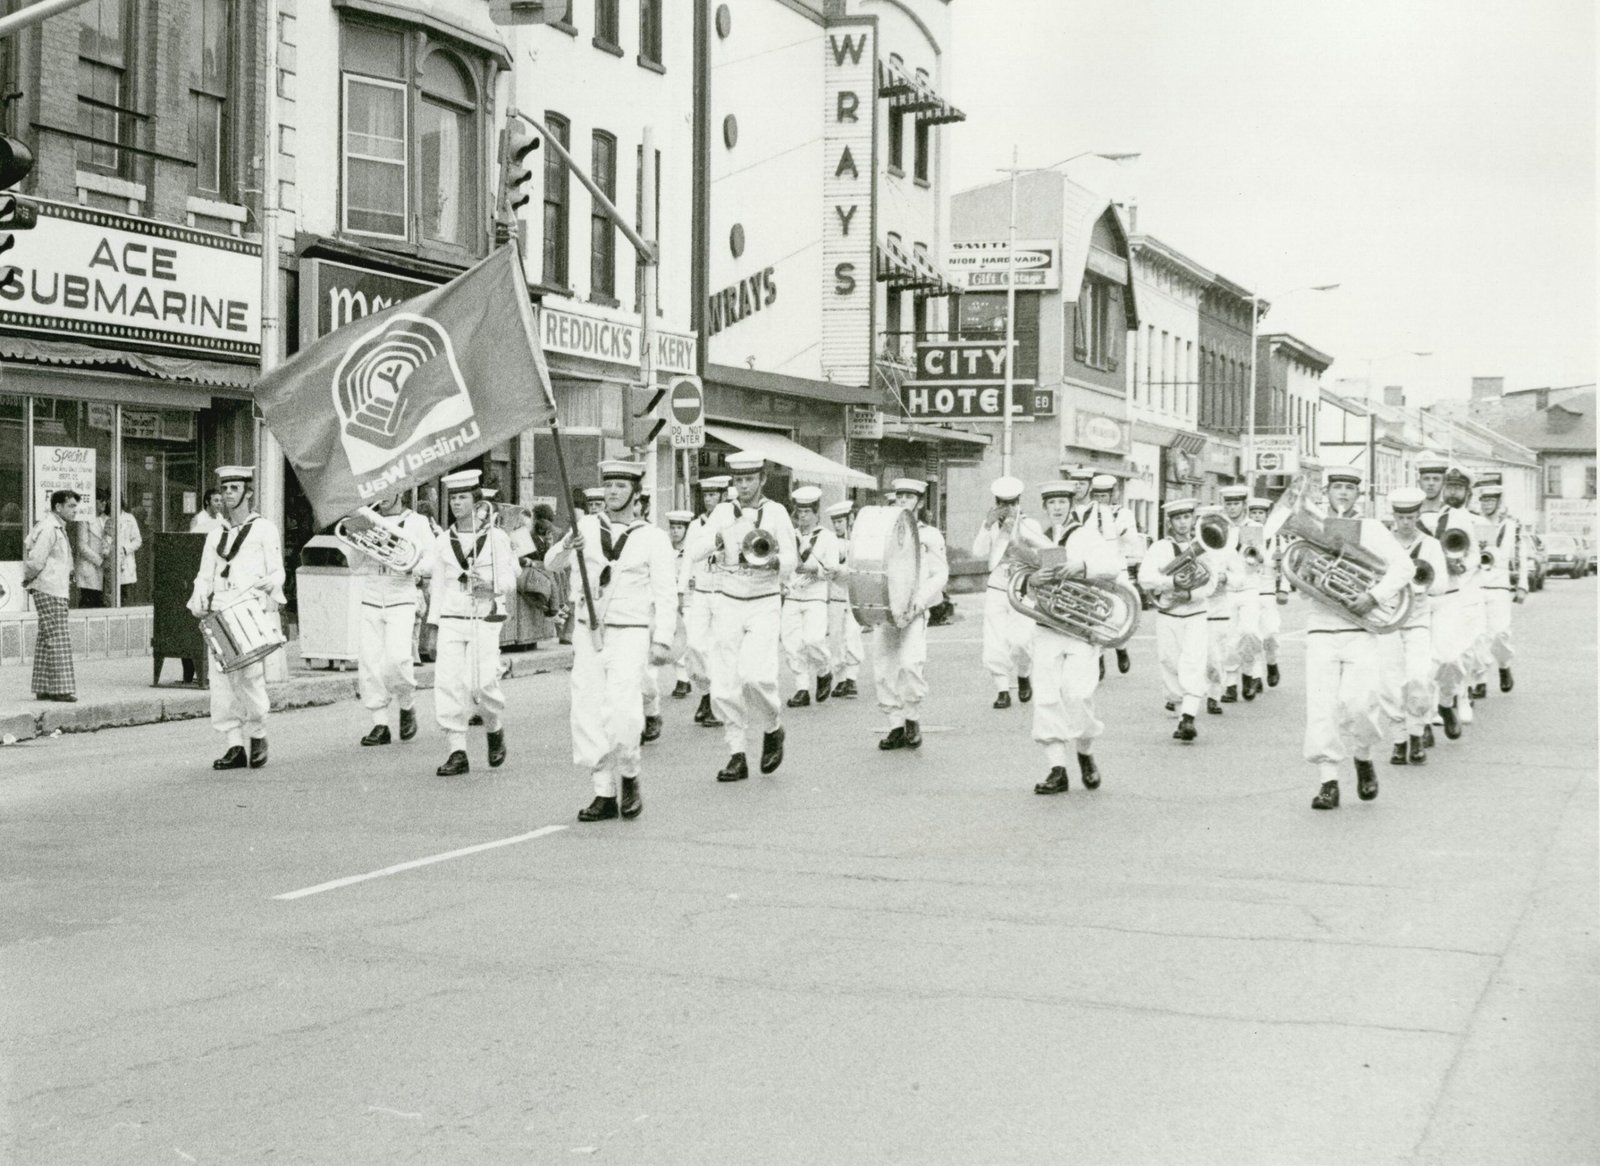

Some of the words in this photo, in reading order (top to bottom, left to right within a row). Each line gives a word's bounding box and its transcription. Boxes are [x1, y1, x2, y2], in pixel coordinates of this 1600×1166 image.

[829, 33, 867, 296] WRAYS
[88, 237, 177, 282] ACE
[948, 257, 976, 265] NION
[1000, 272, 1043, 286] Cttage
[0, 265, 249, 333] SUBMARINE
[707, 266, 777, 337] WRAYS
[545, 312, 633, 361] REDDICK'S
[656, 334, 694, 370] KERY
[924, 348, 1008, 375] CITY
[671, 426, 681, 434] DO
[688, 425, 702, 433] NOT
[674, 434, 700, 444] ENTER
